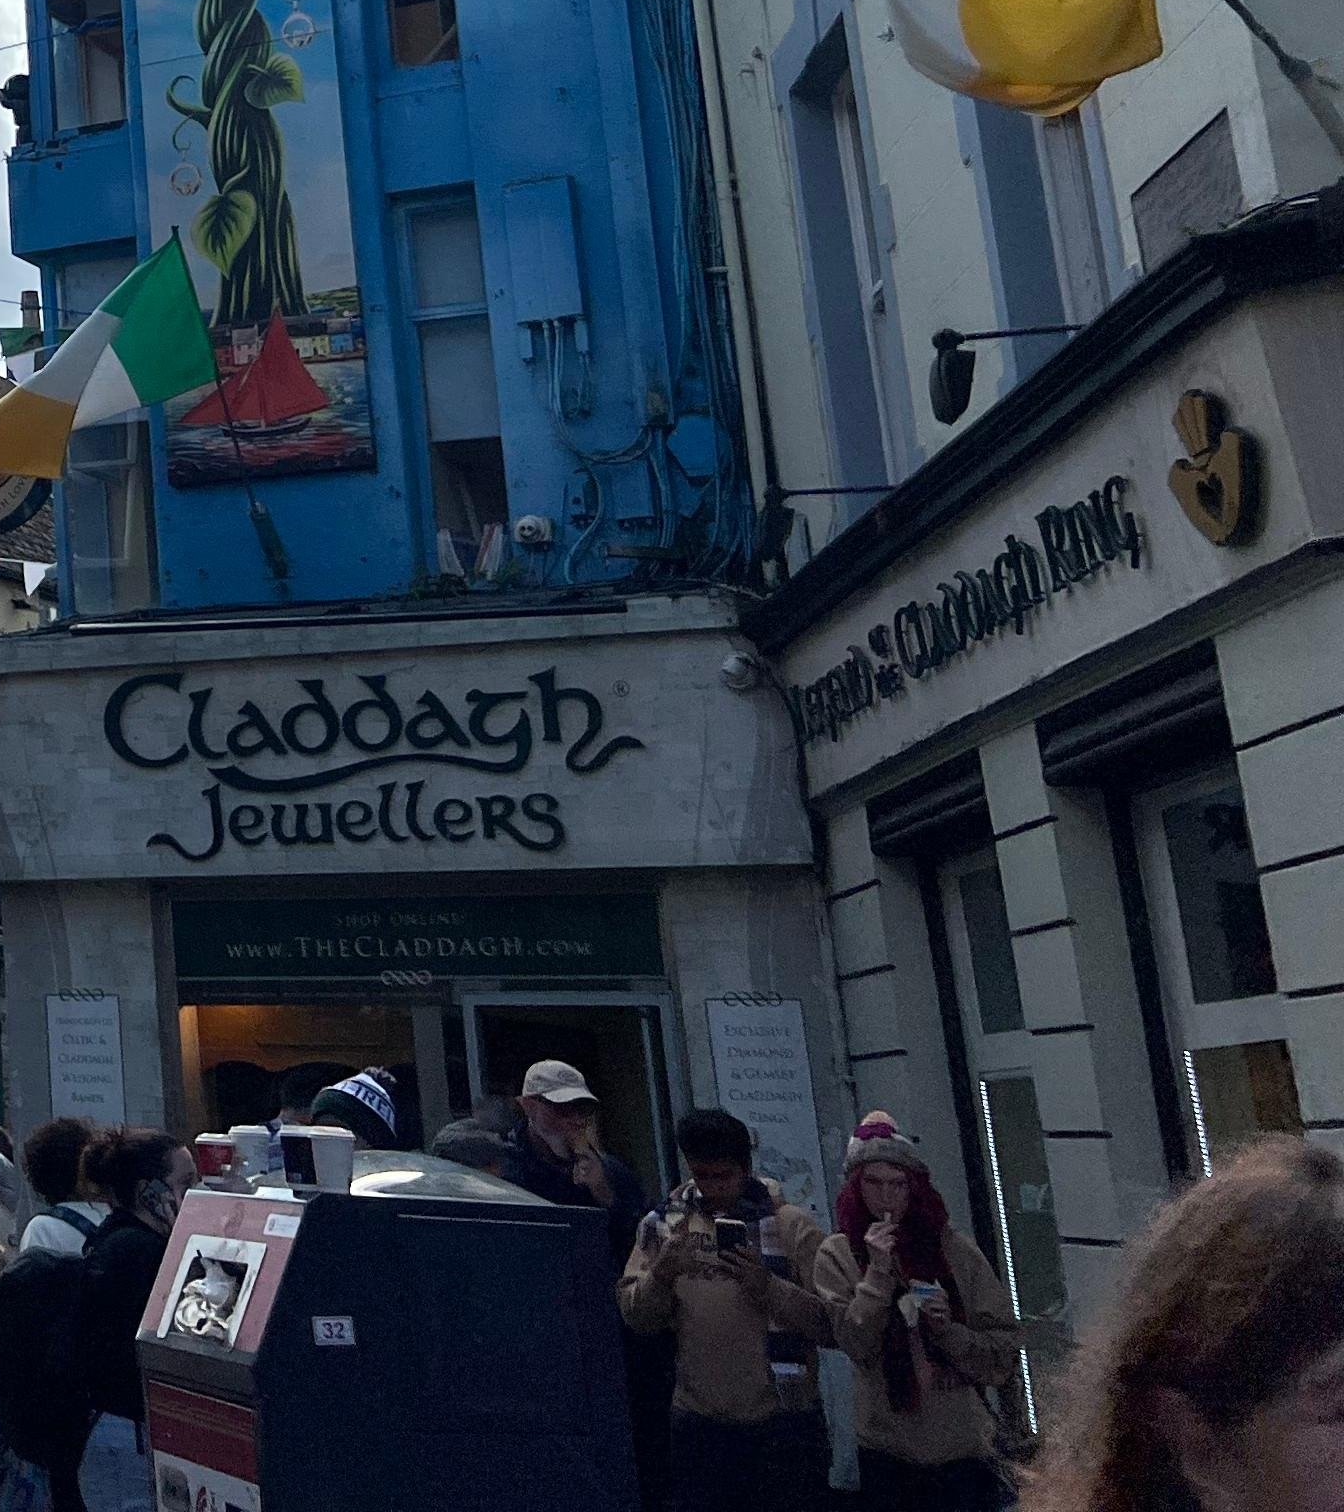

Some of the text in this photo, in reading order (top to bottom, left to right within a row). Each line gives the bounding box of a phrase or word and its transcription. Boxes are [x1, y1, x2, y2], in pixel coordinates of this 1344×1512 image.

[103, 666, 647, 792] Claddagh
[146, 779, 572, 862] Jewellers
[322, 1322, 346, 1339] 32
